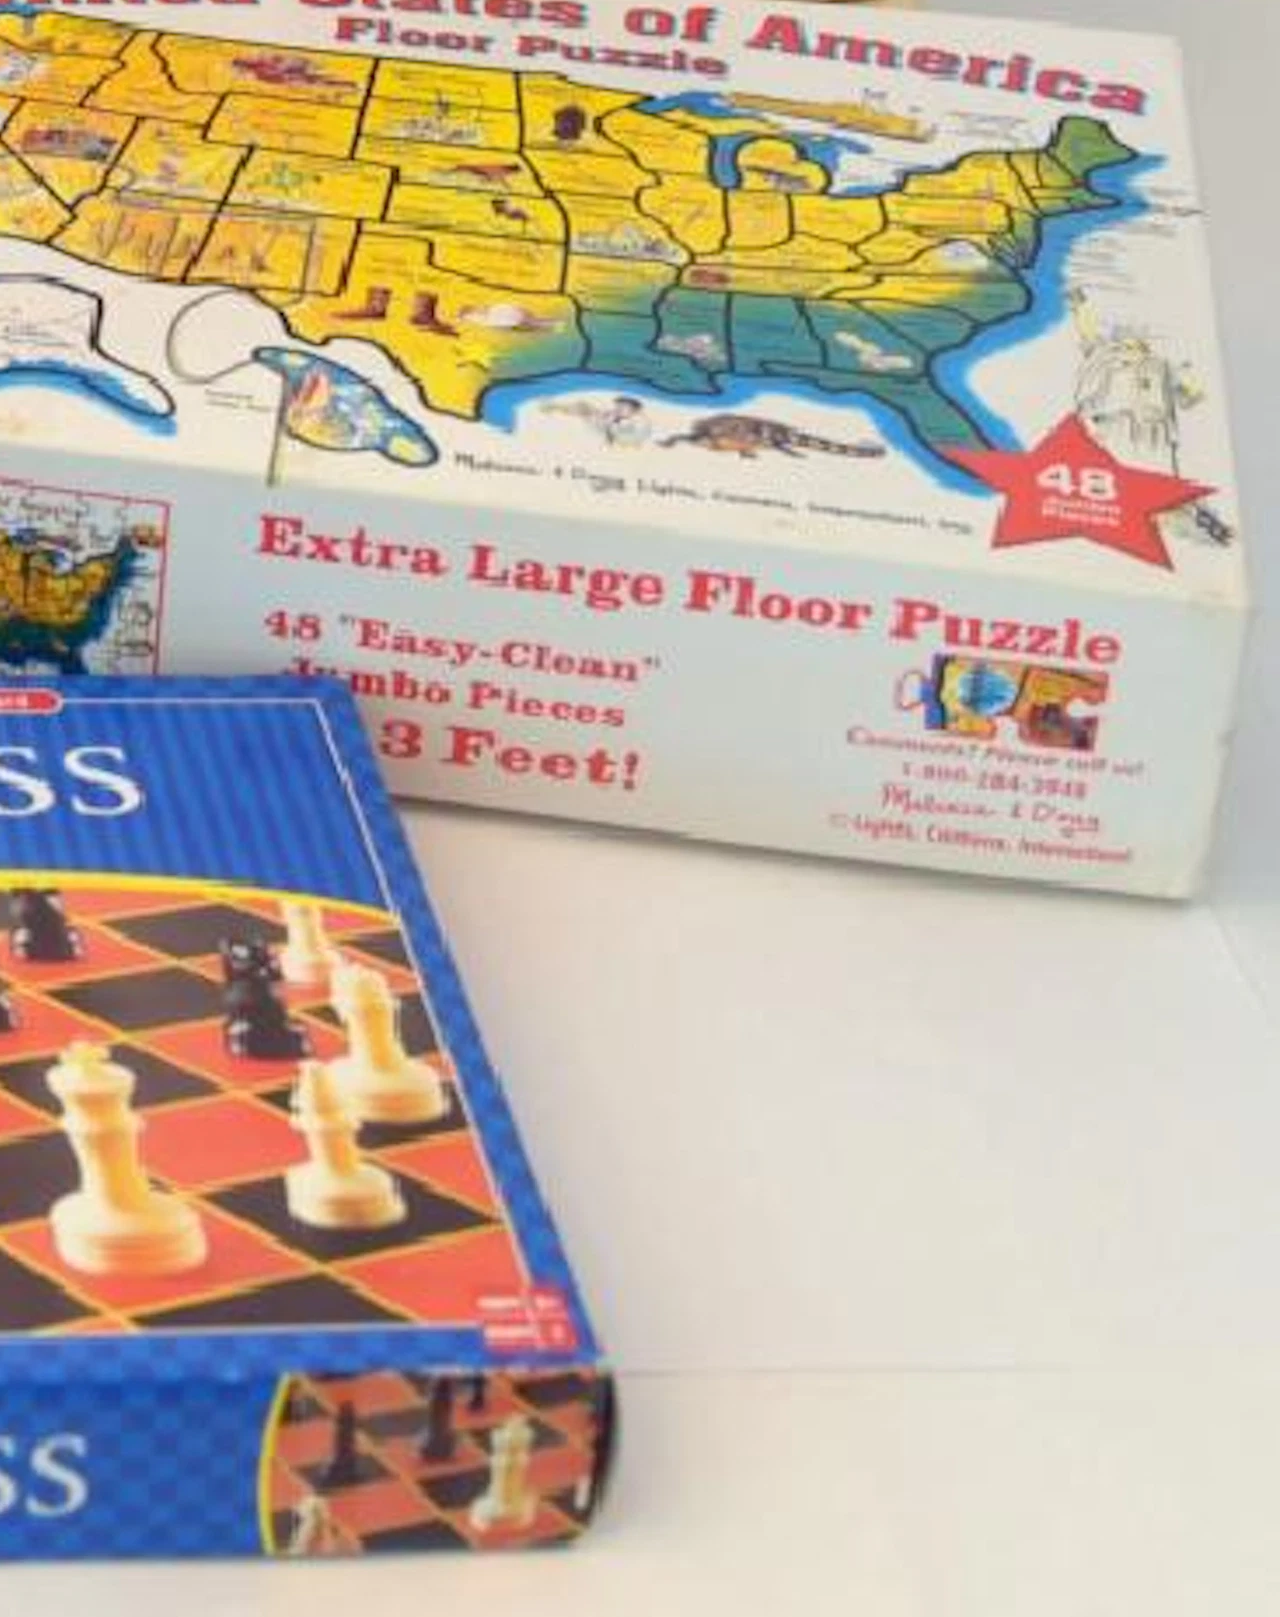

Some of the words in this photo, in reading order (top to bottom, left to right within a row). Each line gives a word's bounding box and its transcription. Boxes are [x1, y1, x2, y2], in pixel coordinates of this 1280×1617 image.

[335, 16, 508, 54] Floor
[517, 33, 729, 79] Puzzle
[622, 3, 724, 45] of
[745, 10, 1151, 117] America
[1035, 463, 1117, 502] 48
[255, 514, 446, 578] Extra
[465, 531, 664, 610] Large
[679, 569, 873, 637] Floor
[888, 597, 1124, 666] Puzzle
[262, 609, 324, 643] 48
[467, 681, 628, 728] Pieces
[440, 726, 642, 791] Feet!
